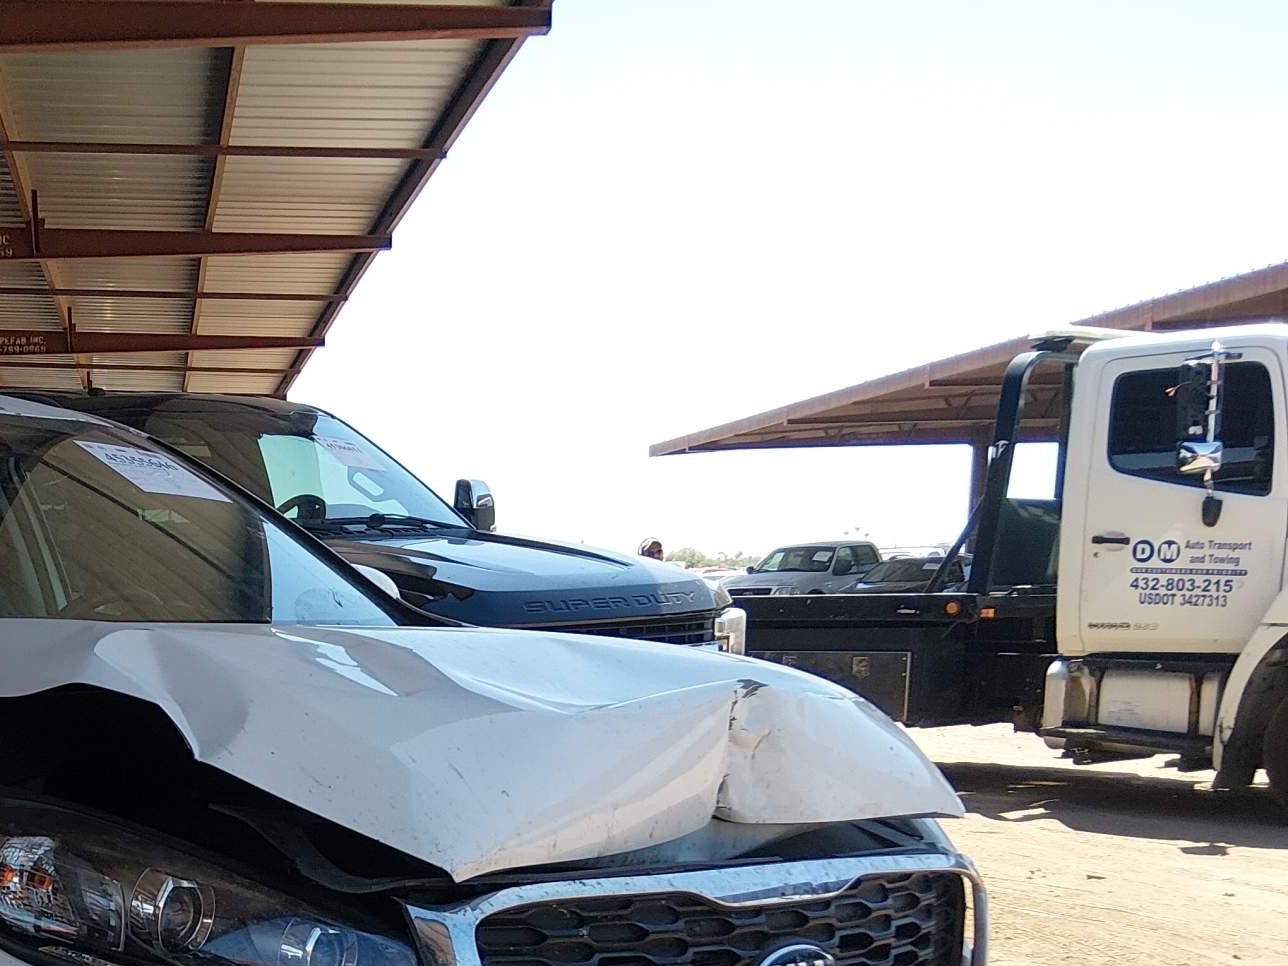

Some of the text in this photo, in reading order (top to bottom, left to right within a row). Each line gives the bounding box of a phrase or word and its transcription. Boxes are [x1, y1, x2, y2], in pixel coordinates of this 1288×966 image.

[1135, 542, 1179, 561] D M
[1184, 540, 1254, 551] Auto Transport
[1188, 554, 1241, 567] and Towing
[522, 590, 695, 614] SUPER DUTY
[1138, 592, 1228, 608] USDOT 3427313
